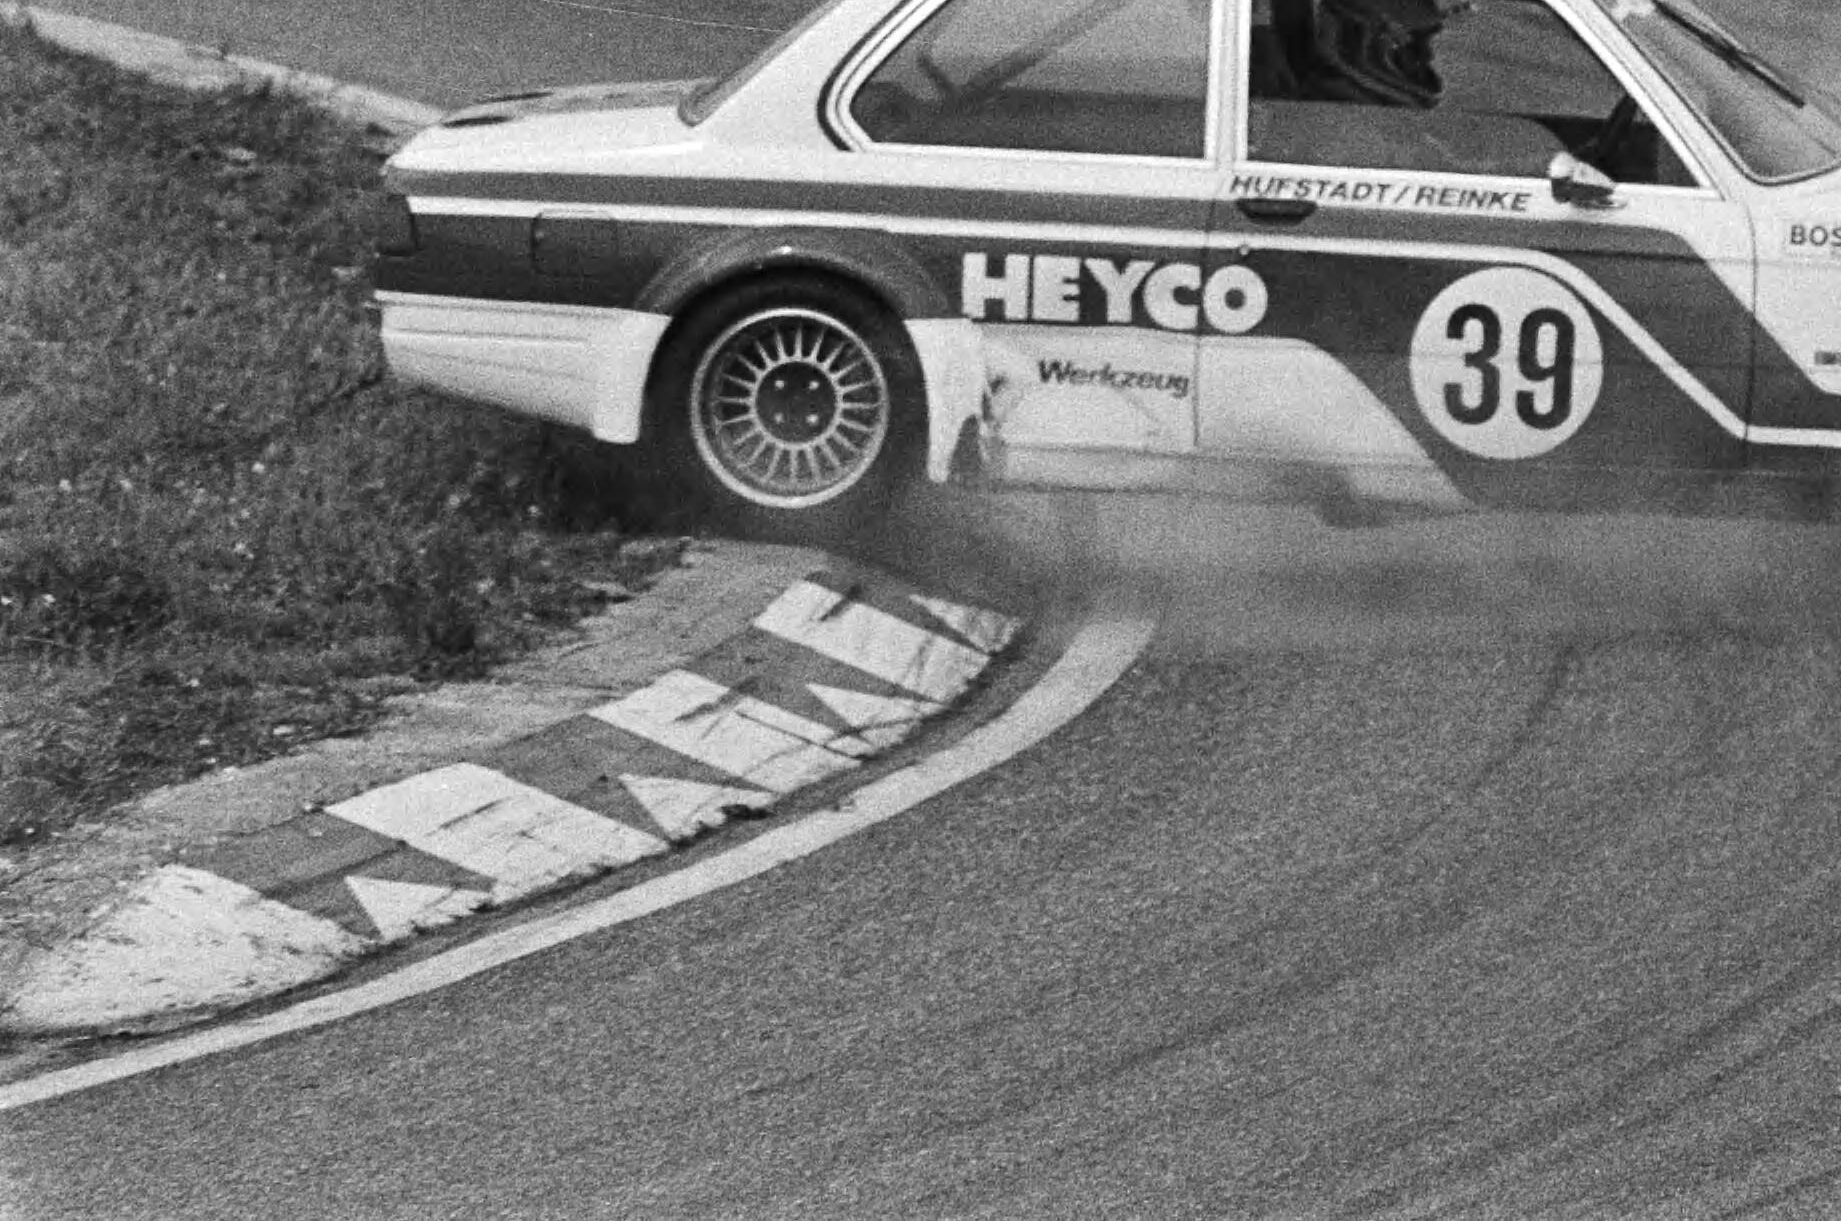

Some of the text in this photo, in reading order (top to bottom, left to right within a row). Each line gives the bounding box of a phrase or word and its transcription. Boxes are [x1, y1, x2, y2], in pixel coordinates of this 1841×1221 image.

[961, 253, 1268, 333] HEYCO
[1037, 359, 1190, 399] Werkzeug
[1443, 303, 1577, 430] 39
